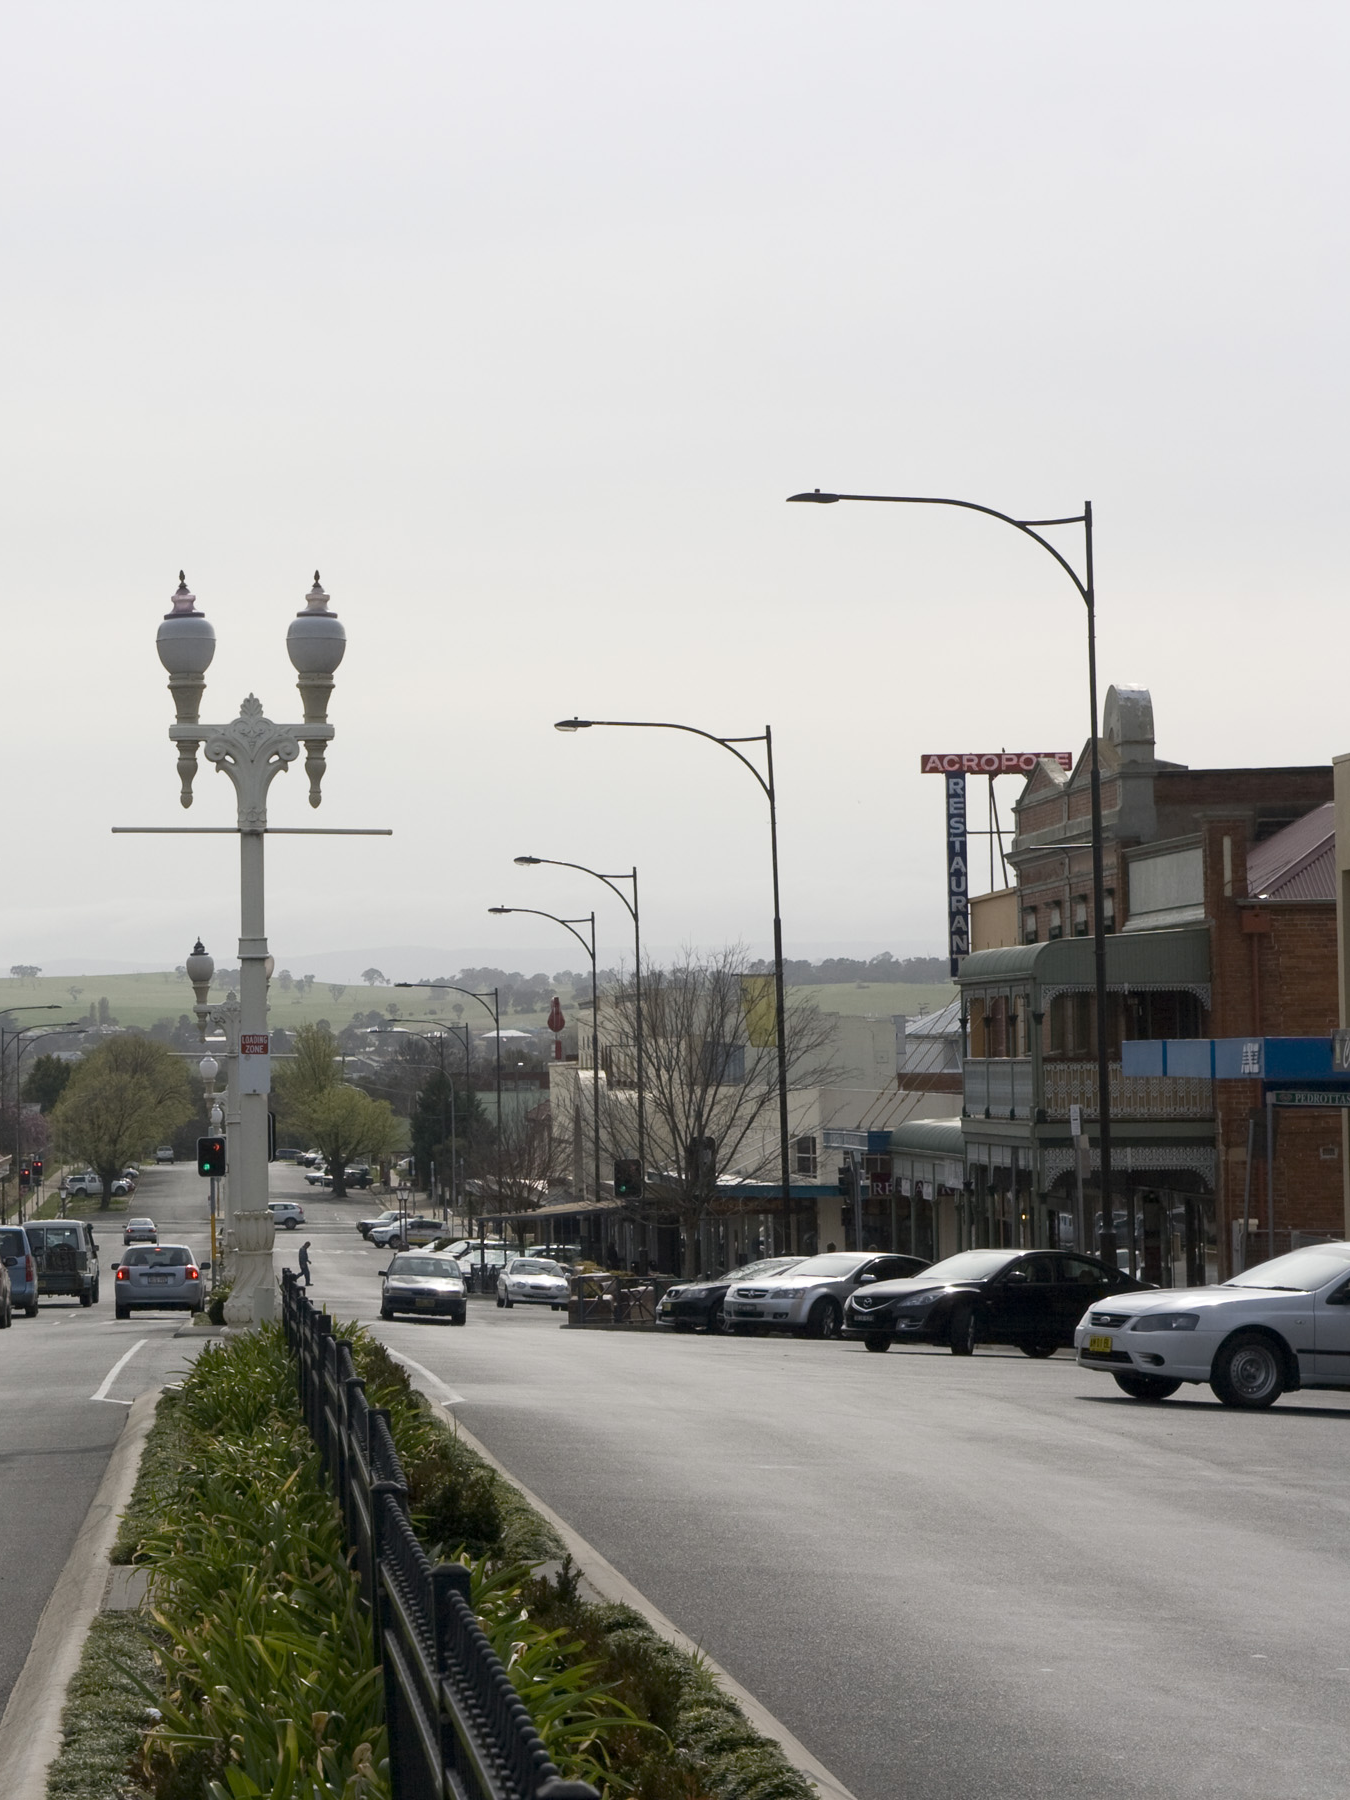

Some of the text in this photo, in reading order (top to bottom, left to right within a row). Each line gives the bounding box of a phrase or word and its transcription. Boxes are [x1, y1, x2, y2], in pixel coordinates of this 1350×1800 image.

[924, 754, 1069, 772] ACROPOE
[242, 1035, 267, 1044] LOADING
[245, 1045, 264, 1053] ZONE
